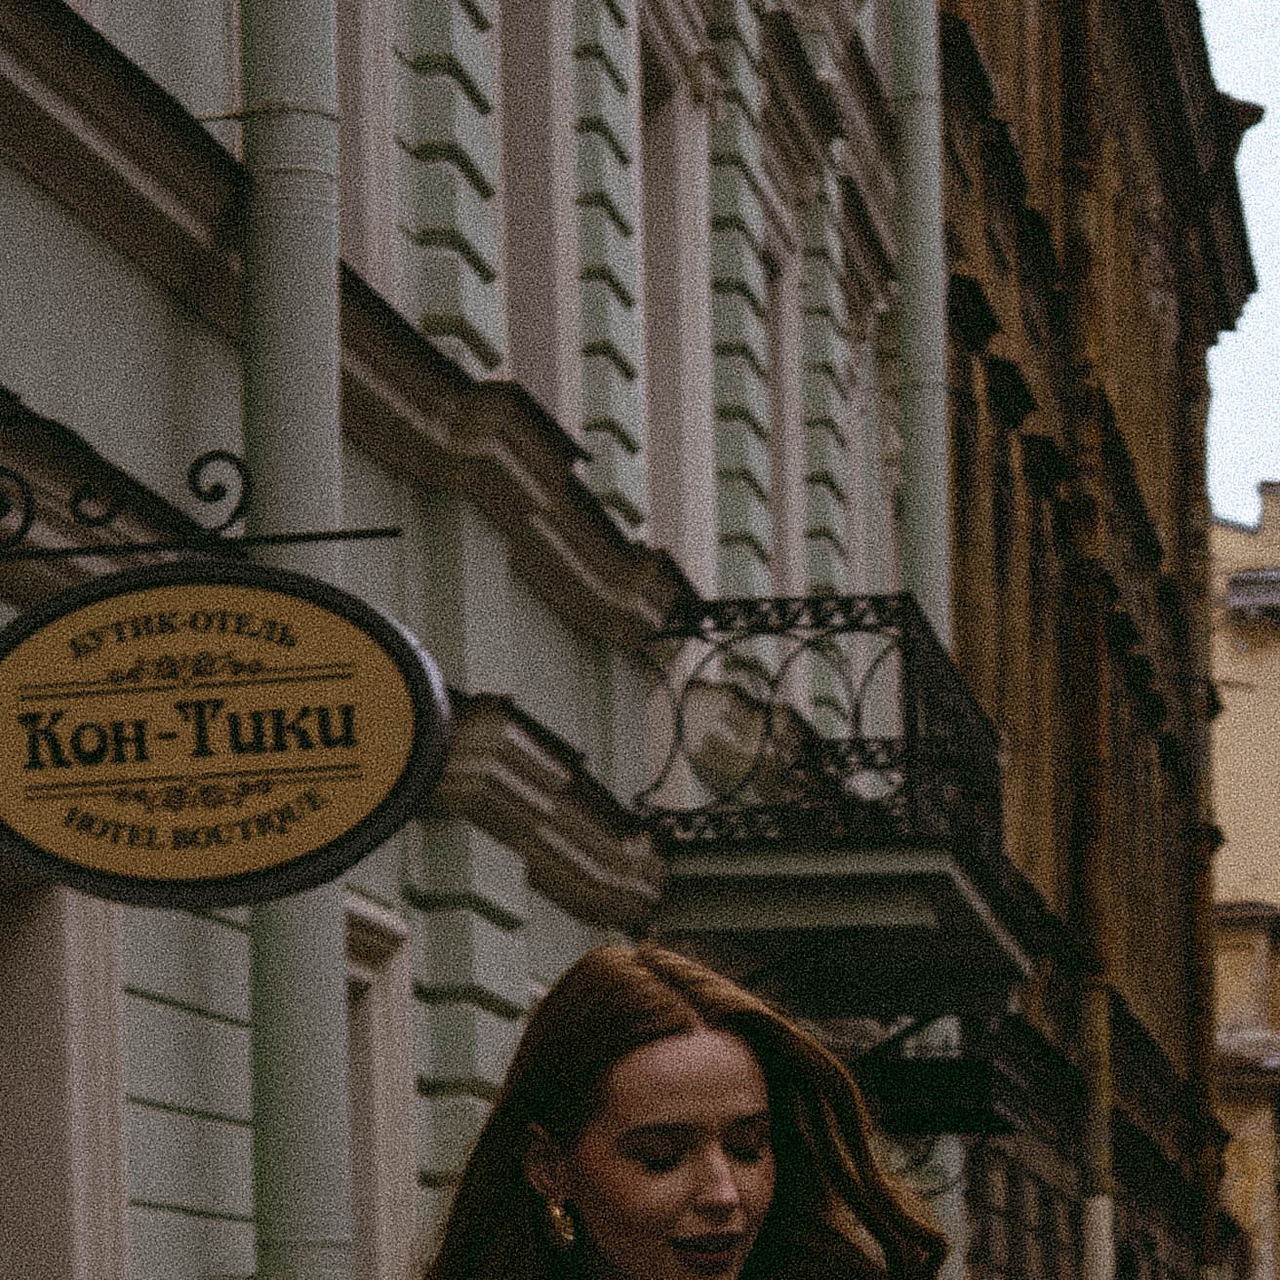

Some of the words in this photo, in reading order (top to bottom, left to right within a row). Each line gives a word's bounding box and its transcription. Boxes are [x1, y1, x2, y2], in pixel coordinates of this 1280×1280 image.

[70, 610, 297, 659] БУТИК-ОТЕЛЬ
[18, 699, 357, 770] Кон-Тики
[64, 806, 163, 850] HOTEL
[171, 789, 326, 850] BOUTIQUE
